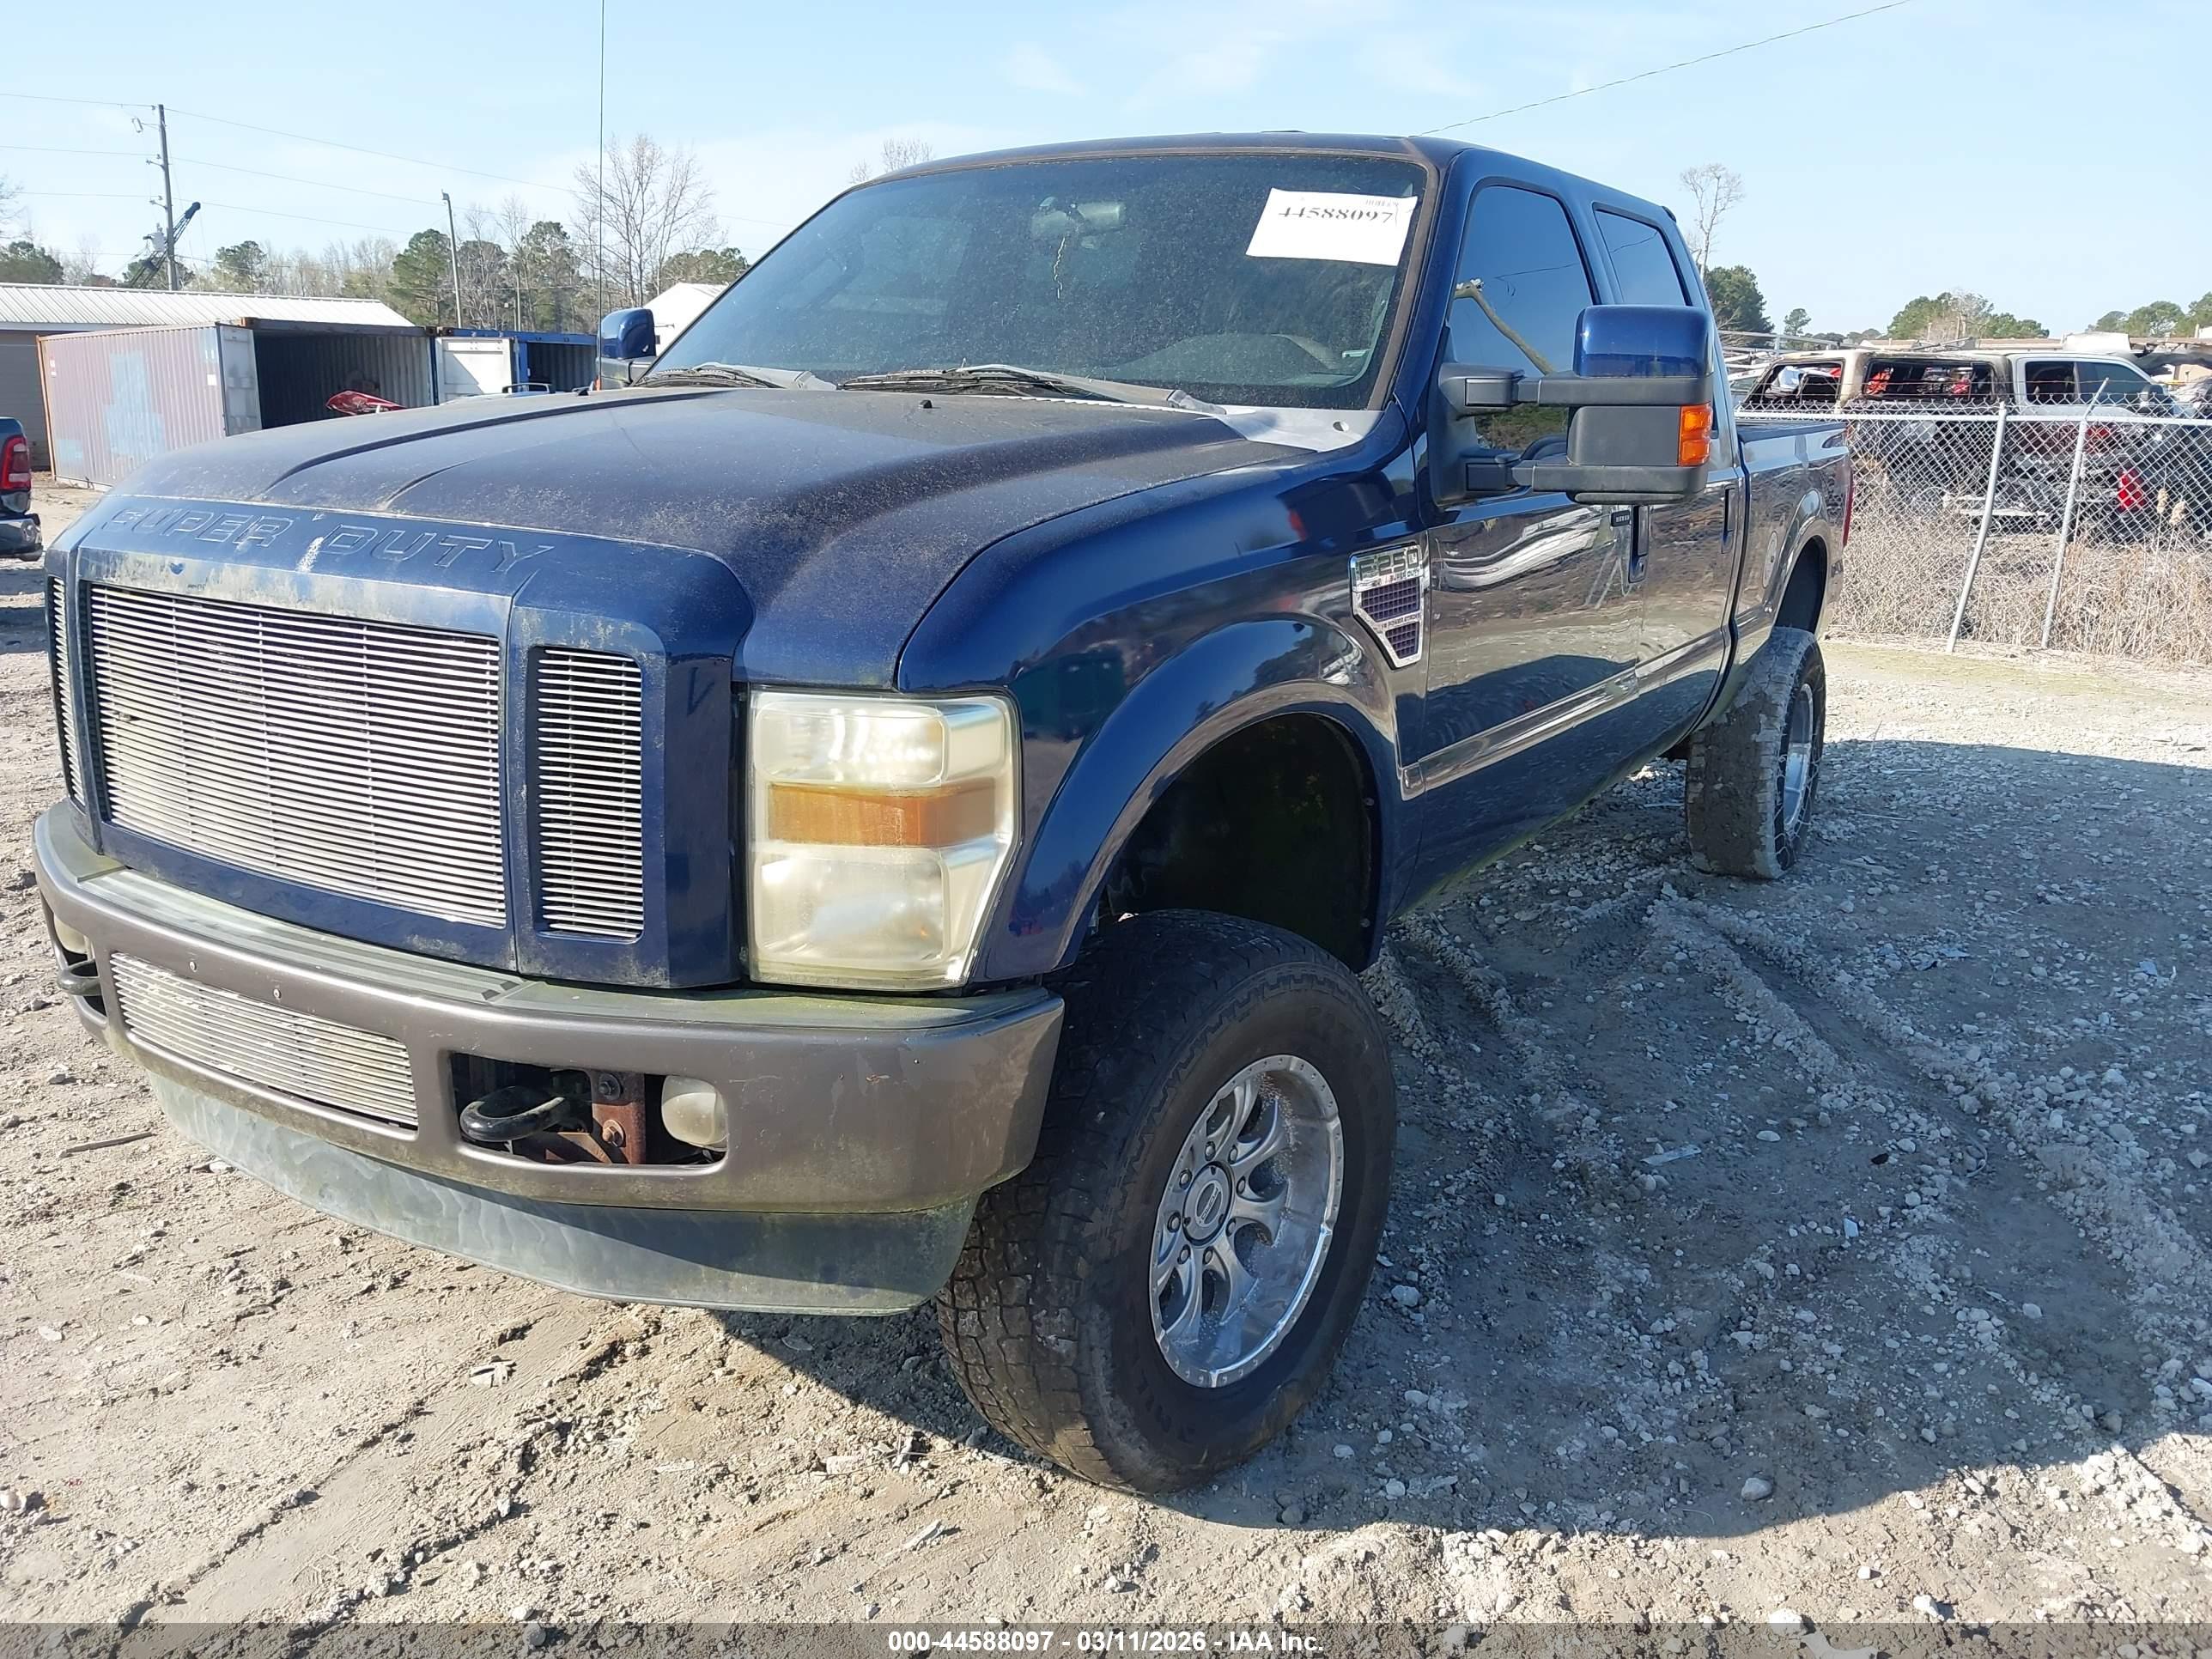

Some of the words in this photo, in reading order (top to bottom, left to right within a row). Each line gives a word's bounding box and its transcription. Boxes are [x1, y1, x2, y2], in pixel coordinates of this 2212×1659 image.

[1279, 206, 1393, 223] 44588097
[99, 507, 295, 548] SUPER
[319, 523, 556, 574] DUTY
